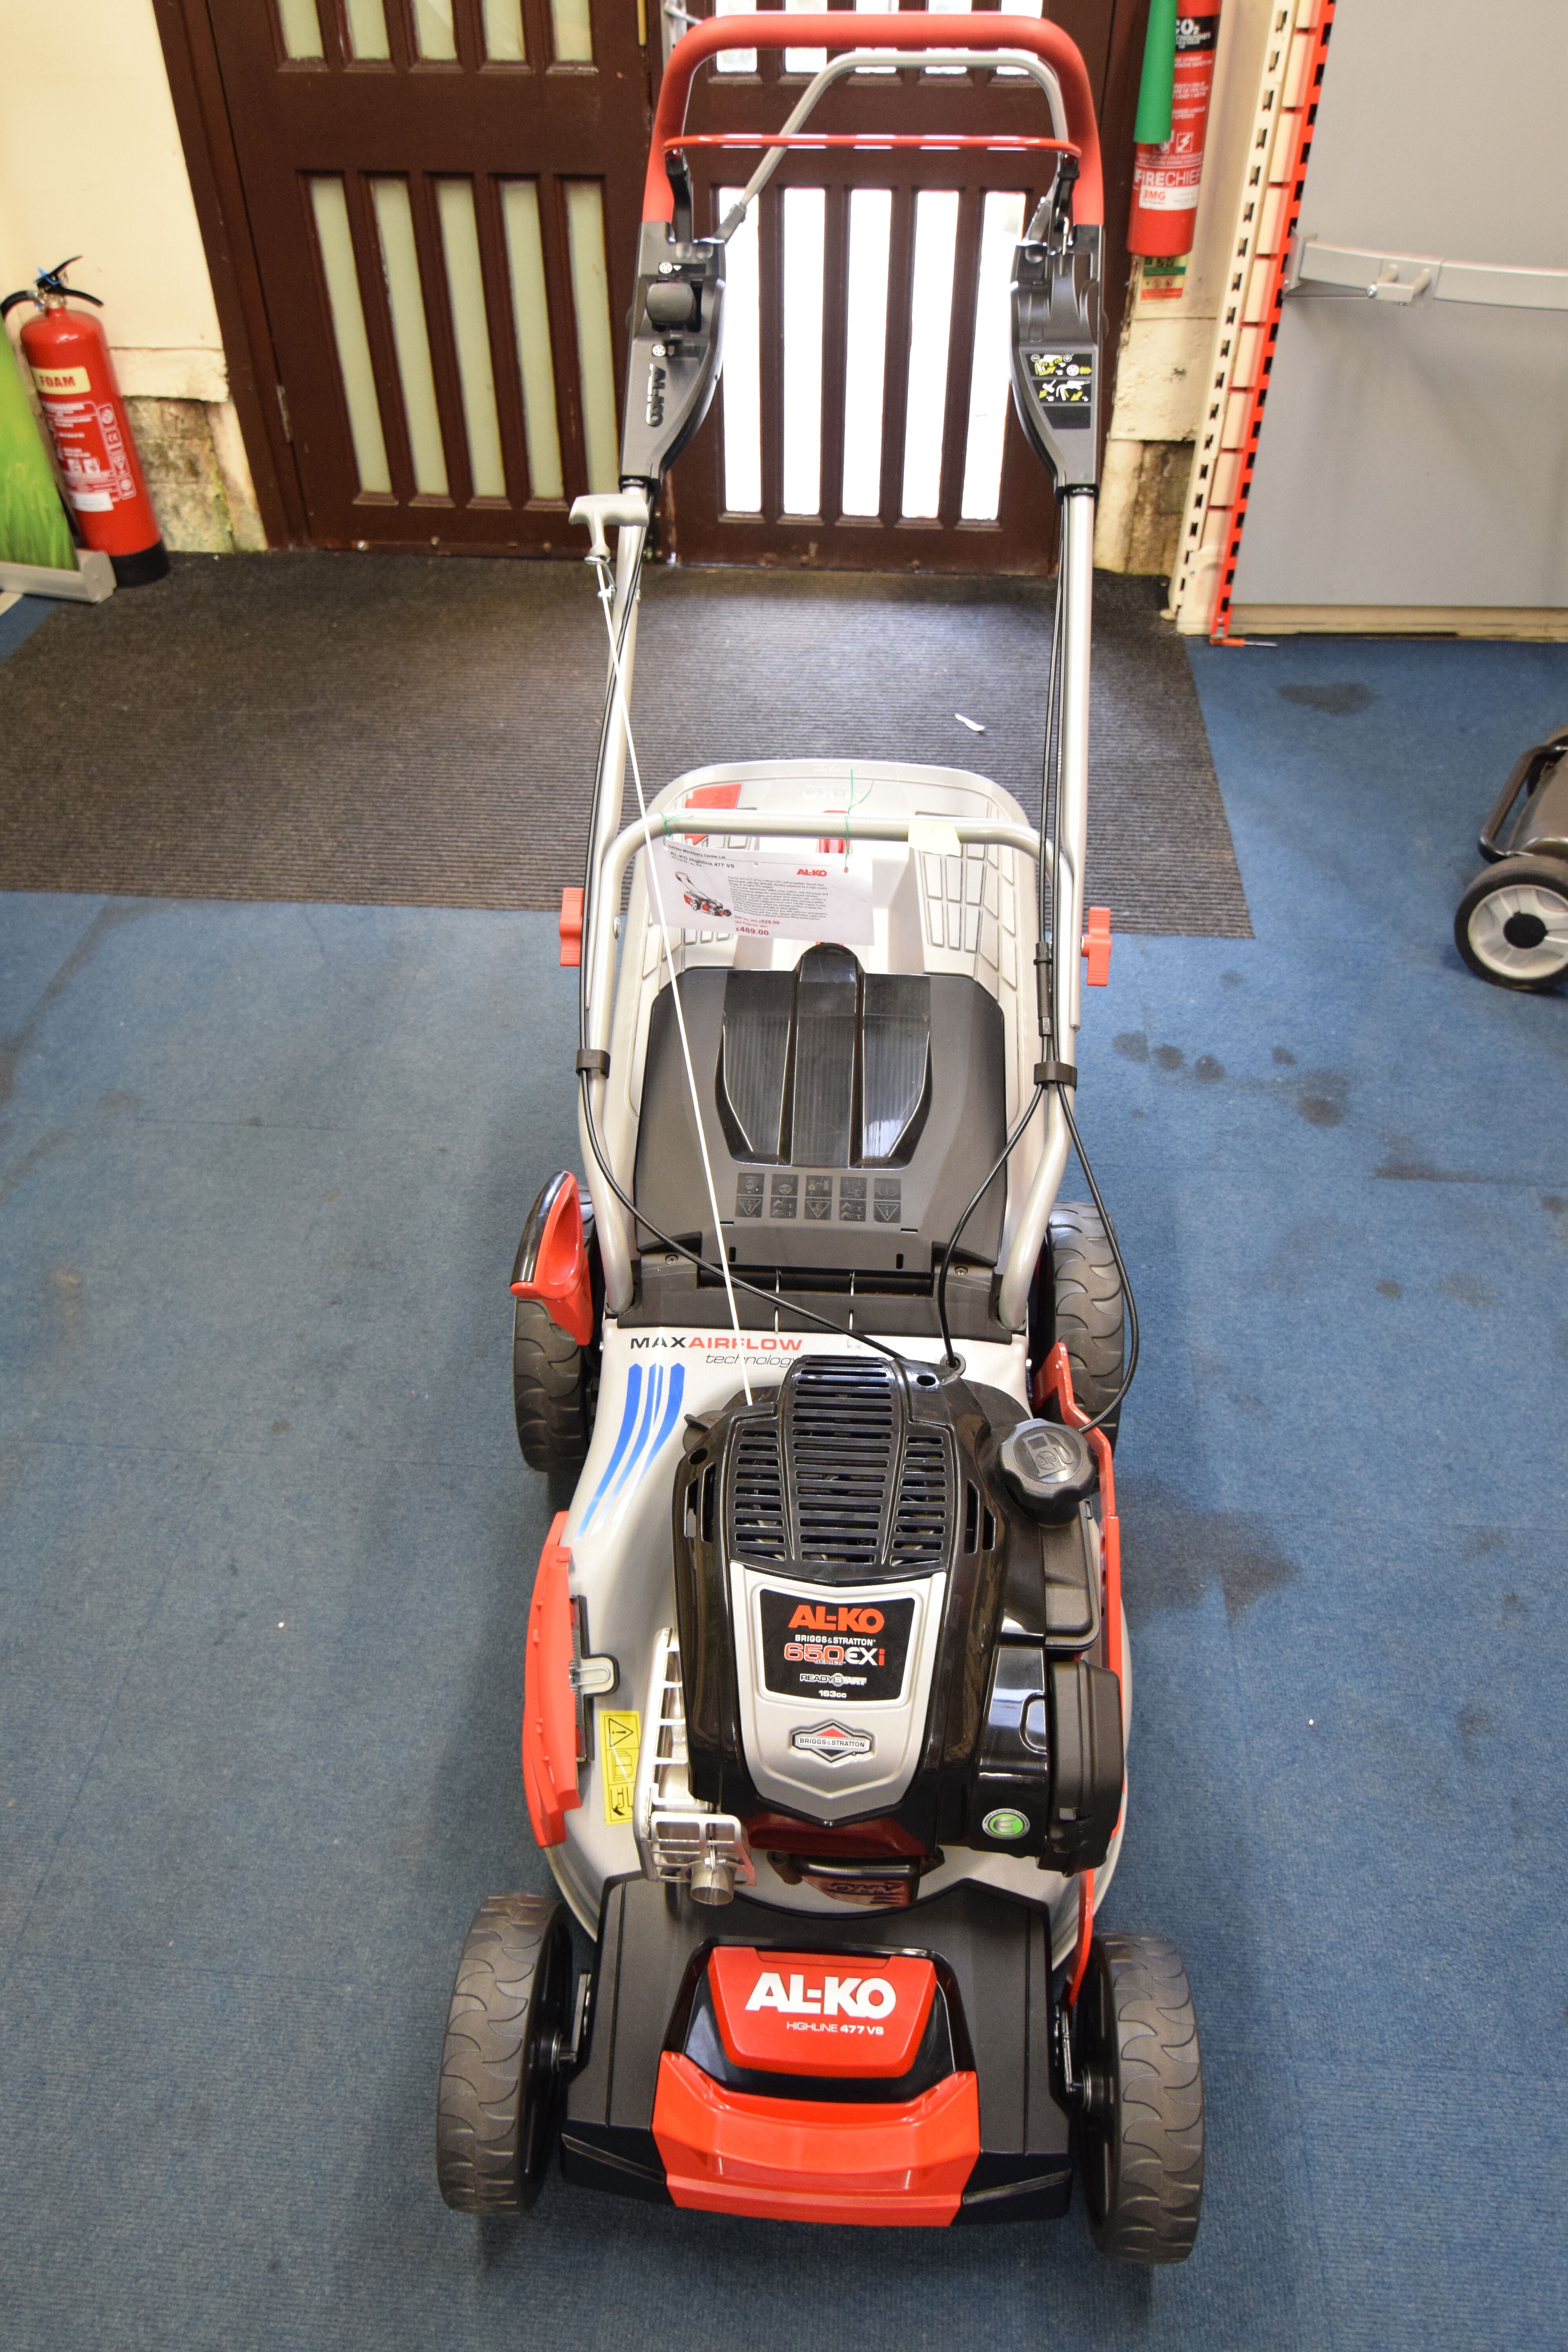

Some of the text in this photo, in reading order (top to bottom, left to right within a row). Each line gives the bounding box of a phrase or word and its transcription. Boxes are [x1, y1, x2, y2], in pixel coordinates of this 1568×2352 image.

[1143, 190, 1165, 201] 3MG
[40, 376, 76, 388] FOAM
[646, 363, 666, 427] AL-KO
[671, 852, 688, 860] AL-KO
[683, 849, 703, 857] Machinery
[797, 868, 827, 877] AL-KO
[736, 927, 769, 936] £489.00
[706, 1354, 795, 1368] technolog
[788, 1605, 884, 1633] AL-KO
[818, 1690, 847, 1698] 163cc
[745, 1972, 896, 2019] AL-KO
[787, 2021, 884, 2035] HIGHLINE 477 VS
